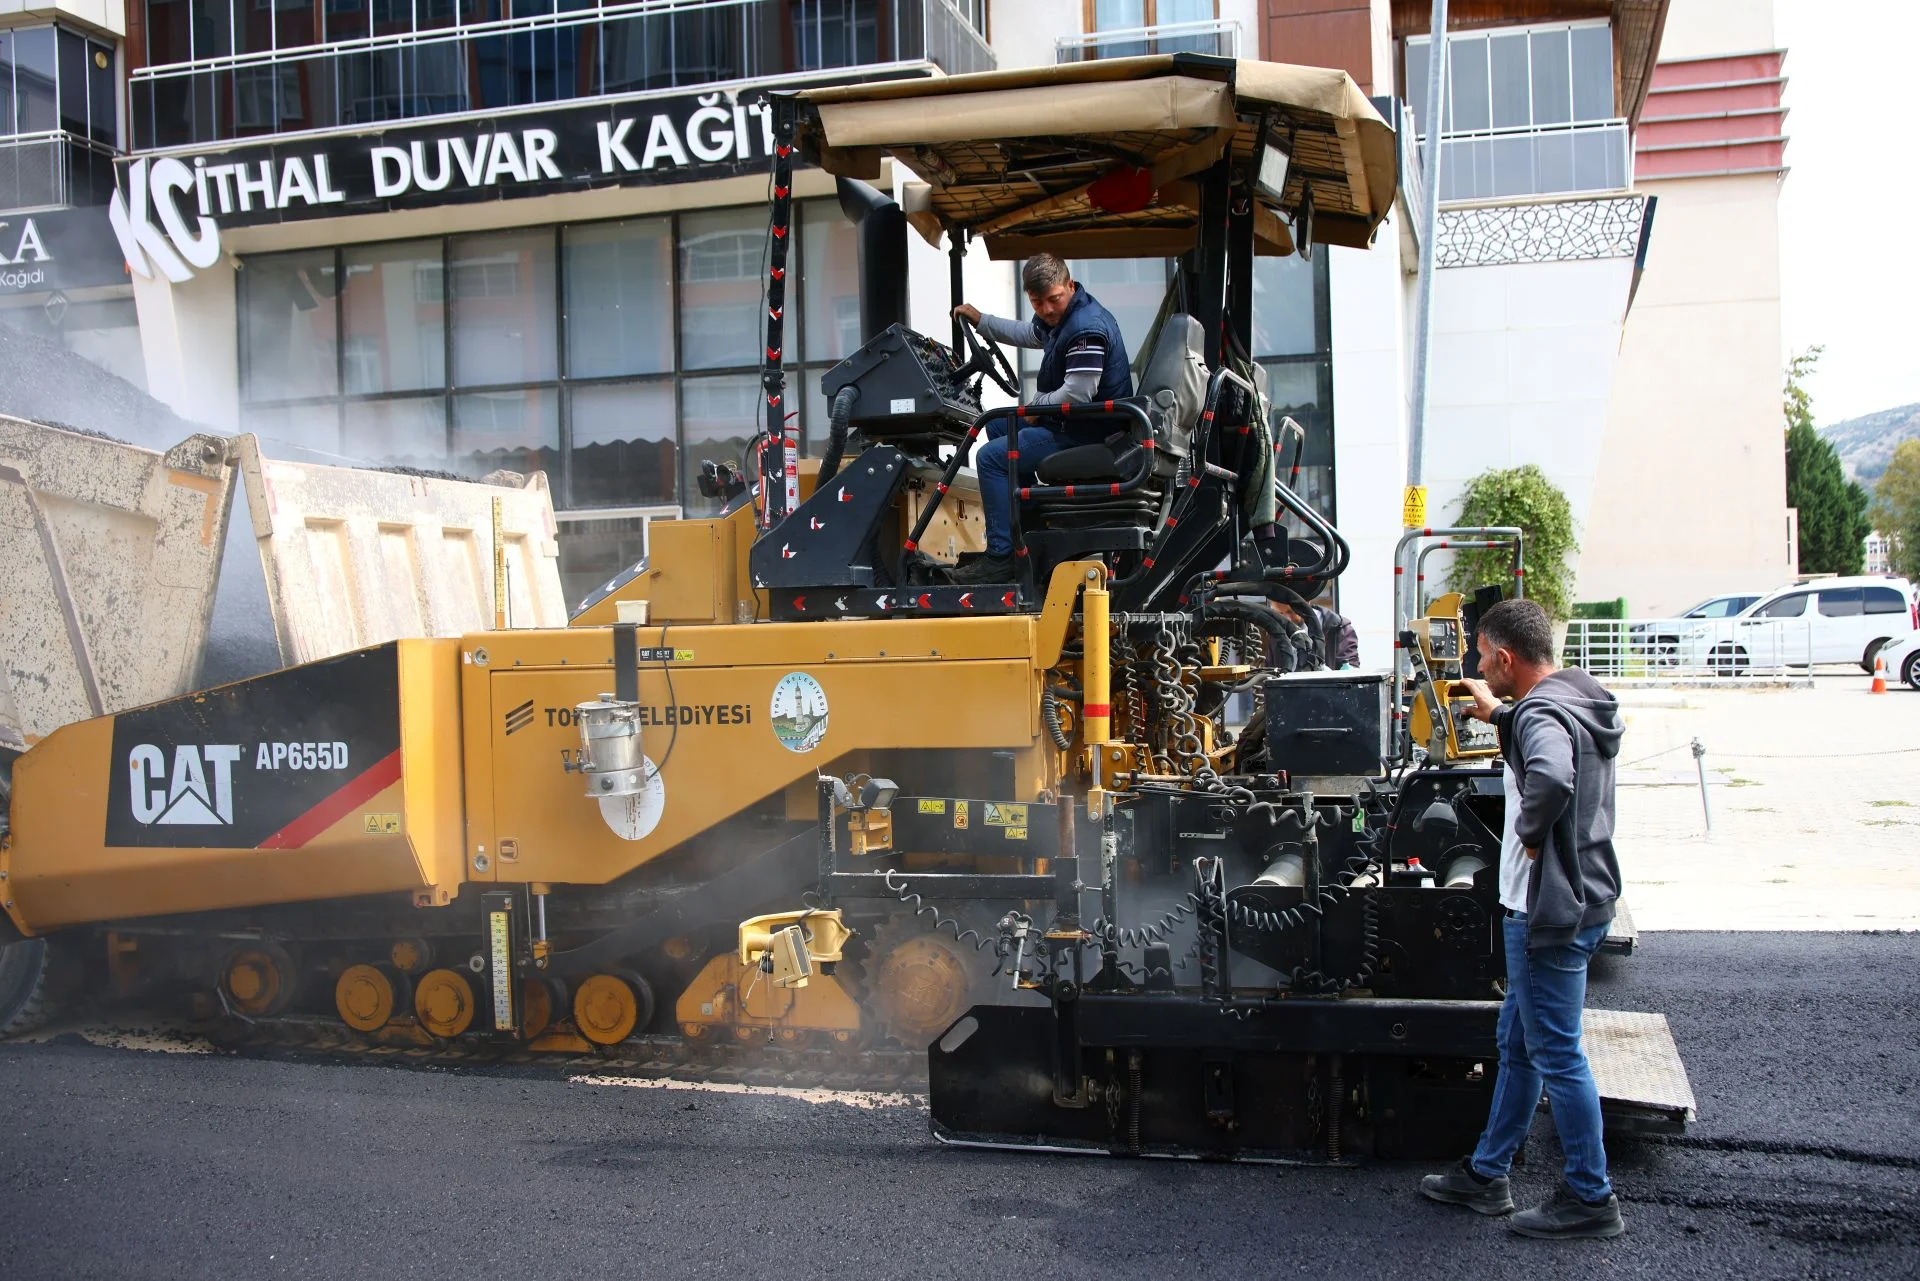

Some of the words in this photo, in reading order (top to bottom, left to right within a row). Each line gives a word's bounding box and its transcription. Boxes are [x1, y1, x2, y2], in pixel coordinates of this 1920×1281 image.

[194, 156, 346, 216] İTHAL
[370, 128, 563, 198] DUVAR
[596, 92, 800, 174] KAĞIT
[129, 744, 241, 825] CAT
[256, 742, 349, 770] AP655D
